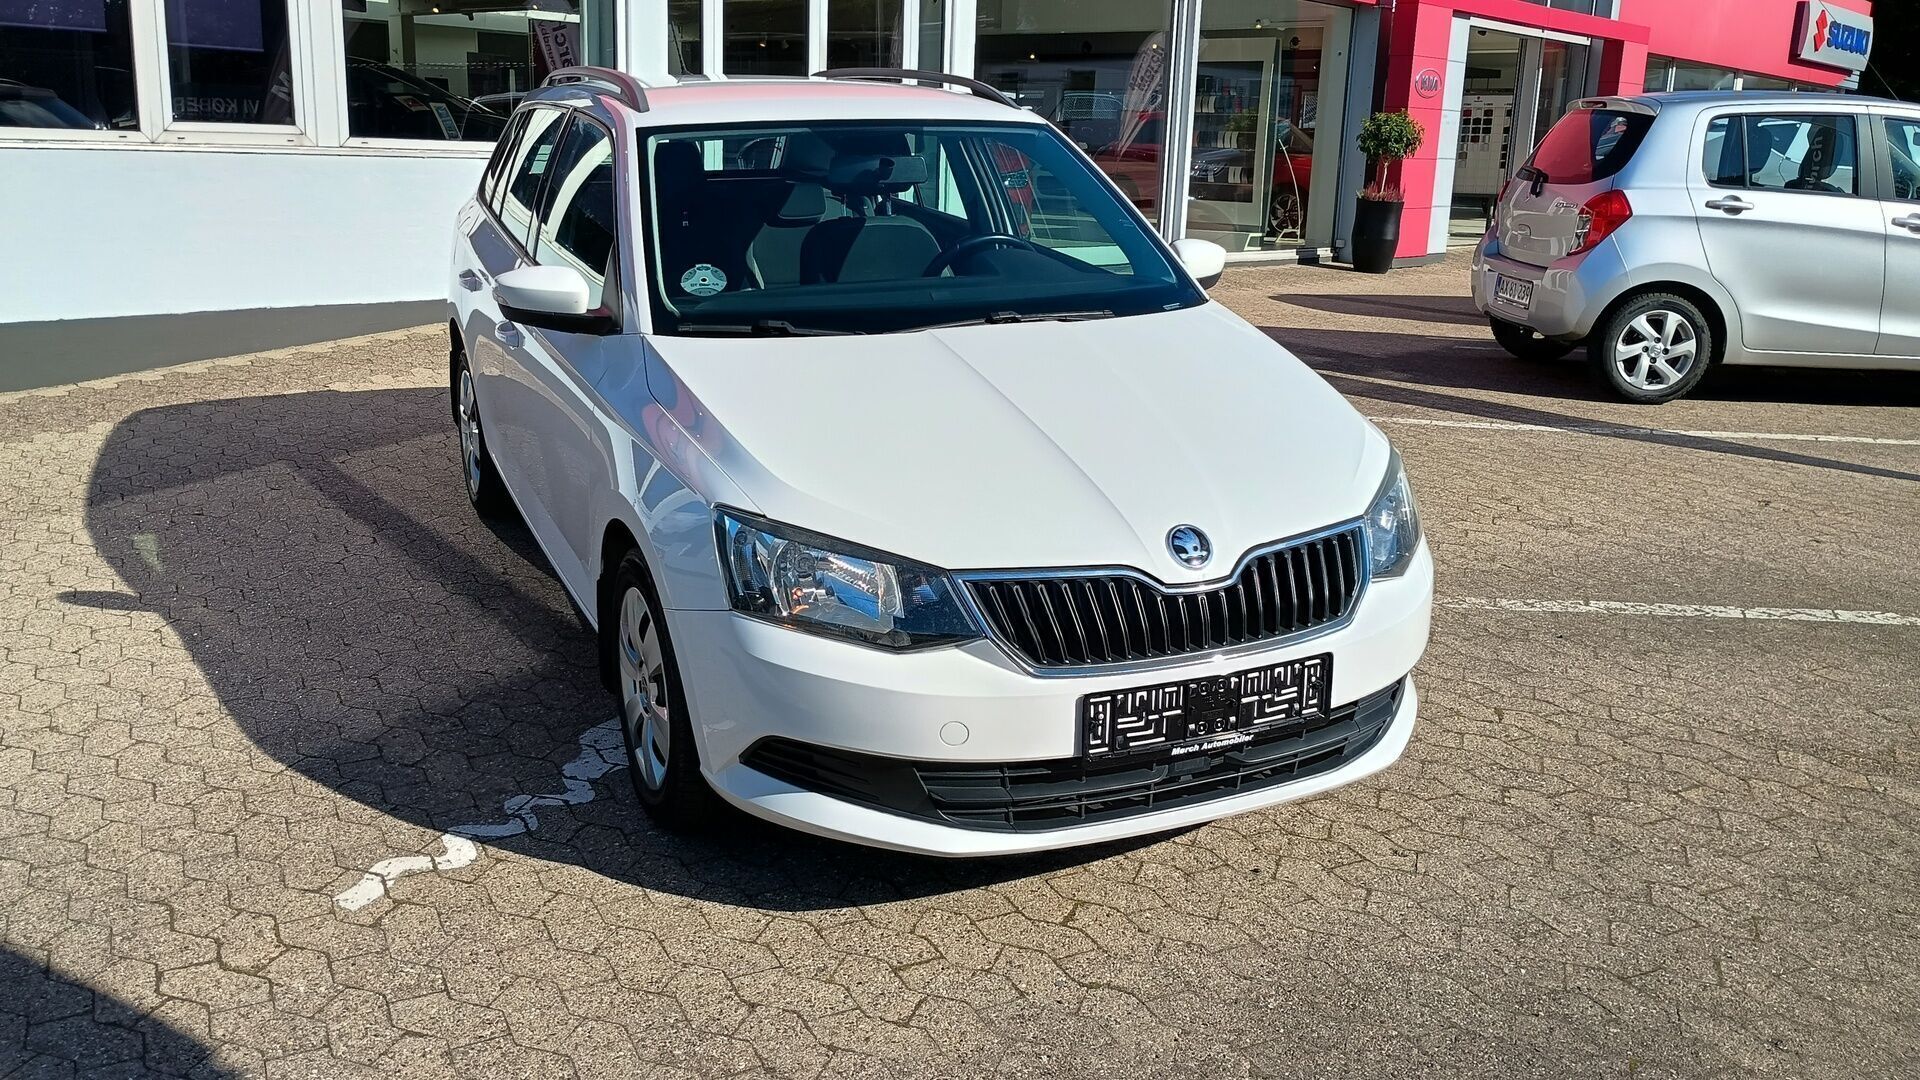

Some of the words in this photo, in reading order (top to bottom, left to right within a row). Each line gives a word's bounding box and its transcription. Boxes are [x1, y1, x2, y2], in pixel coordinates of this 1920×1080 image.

[1827, 21, 1870, 55] SUZUKI
[1500, 280, 1510, 296] AX
[1200, 734, 1254, 750] Automobiler
